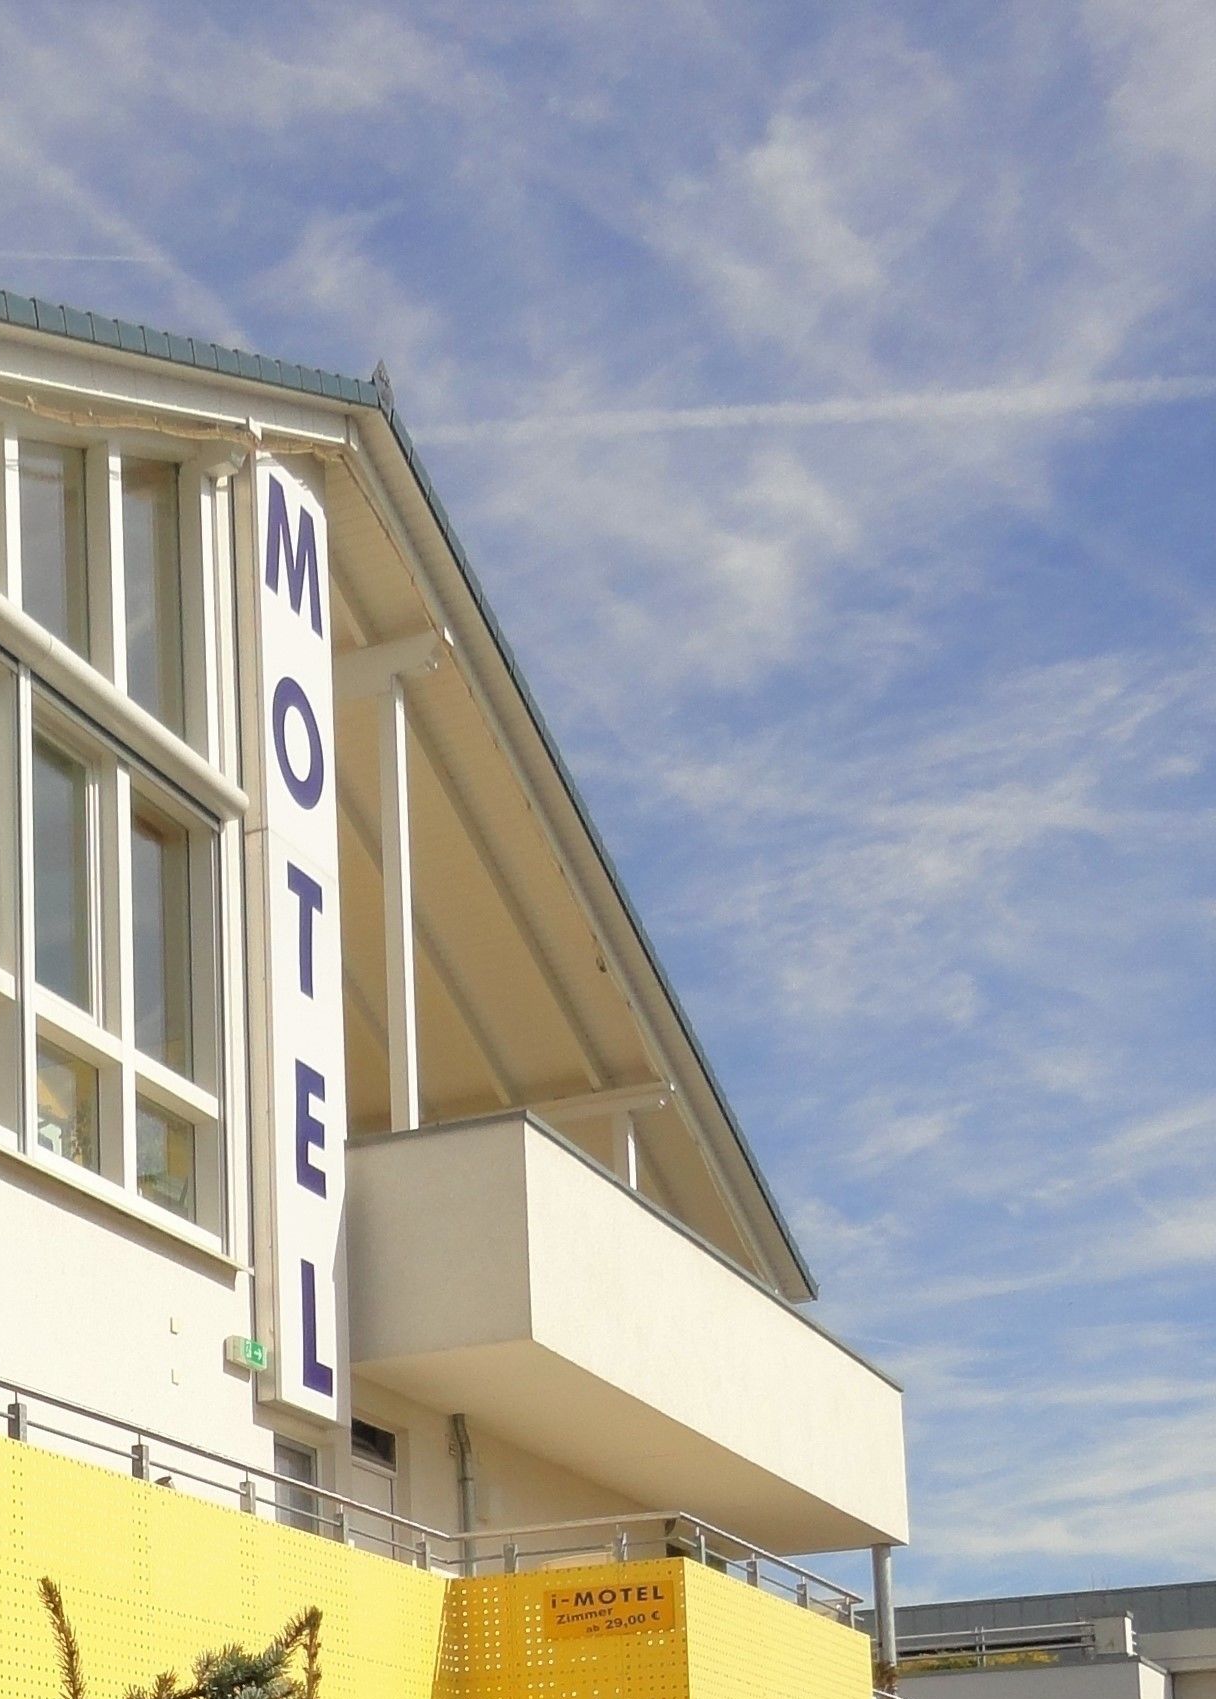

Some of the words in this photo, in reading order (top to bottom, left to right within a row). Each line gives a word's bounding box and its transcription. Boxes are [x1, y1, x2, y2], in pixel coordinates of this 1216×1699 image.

[264, 472, 333, 1398] MOTEL
[551, 1585, 665, 1609] i-MOTEL
[556, 1607, 614, 1625] Zimmer
[586, 1624, 600, 1633] ab
[605, 1613, 646, 1631] 29,00
[651, 1610, 661, 1621] €
